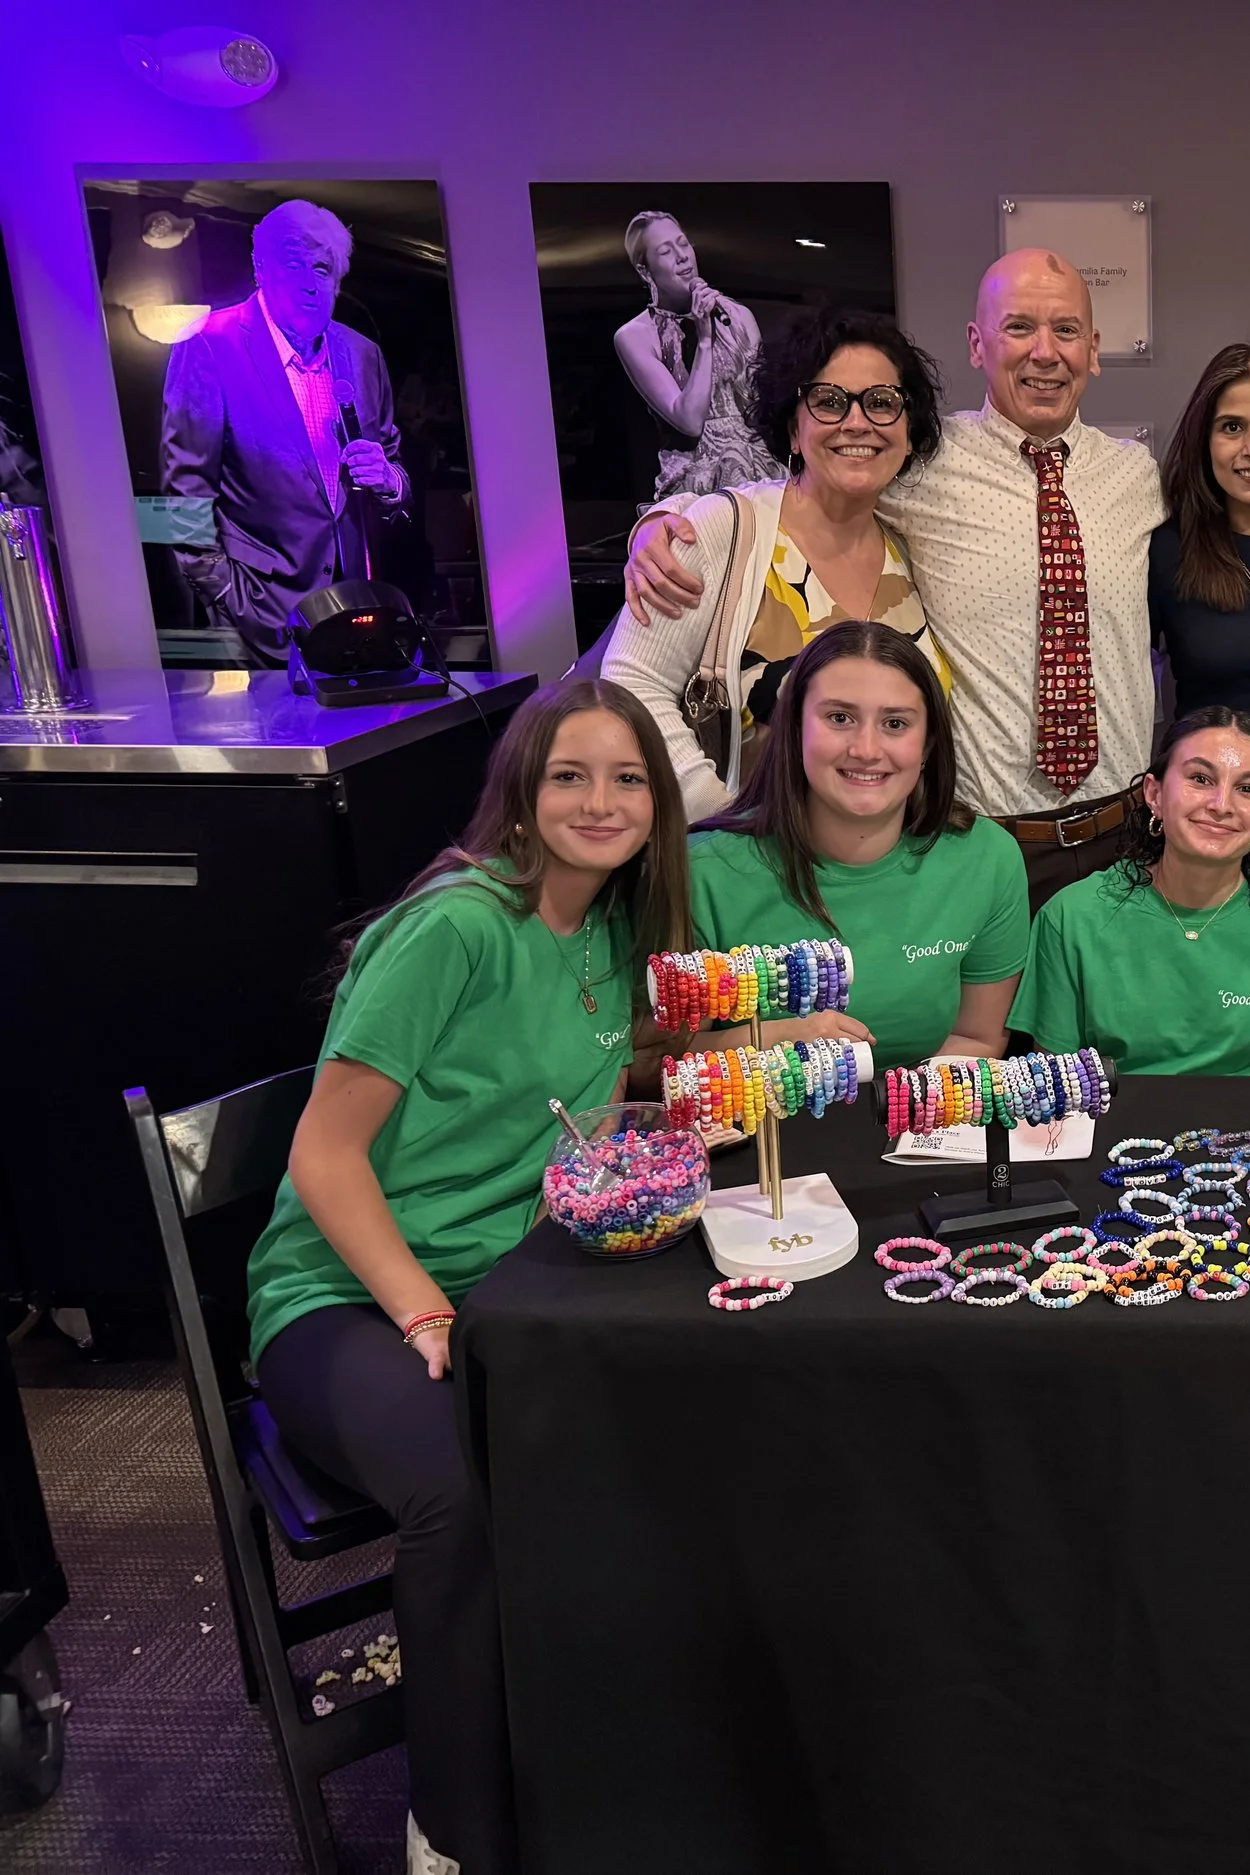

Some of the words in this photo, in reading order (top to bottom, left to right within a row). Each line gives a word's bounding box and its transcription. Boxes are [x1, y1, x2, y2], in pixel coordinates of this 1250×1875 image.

[1078, 266, 1098, 275] milia
[1100, 266, 1127, 277] Family
[1095, 278, 1110, 286] Bar
[768, 1233, 814, 1253] fyb
